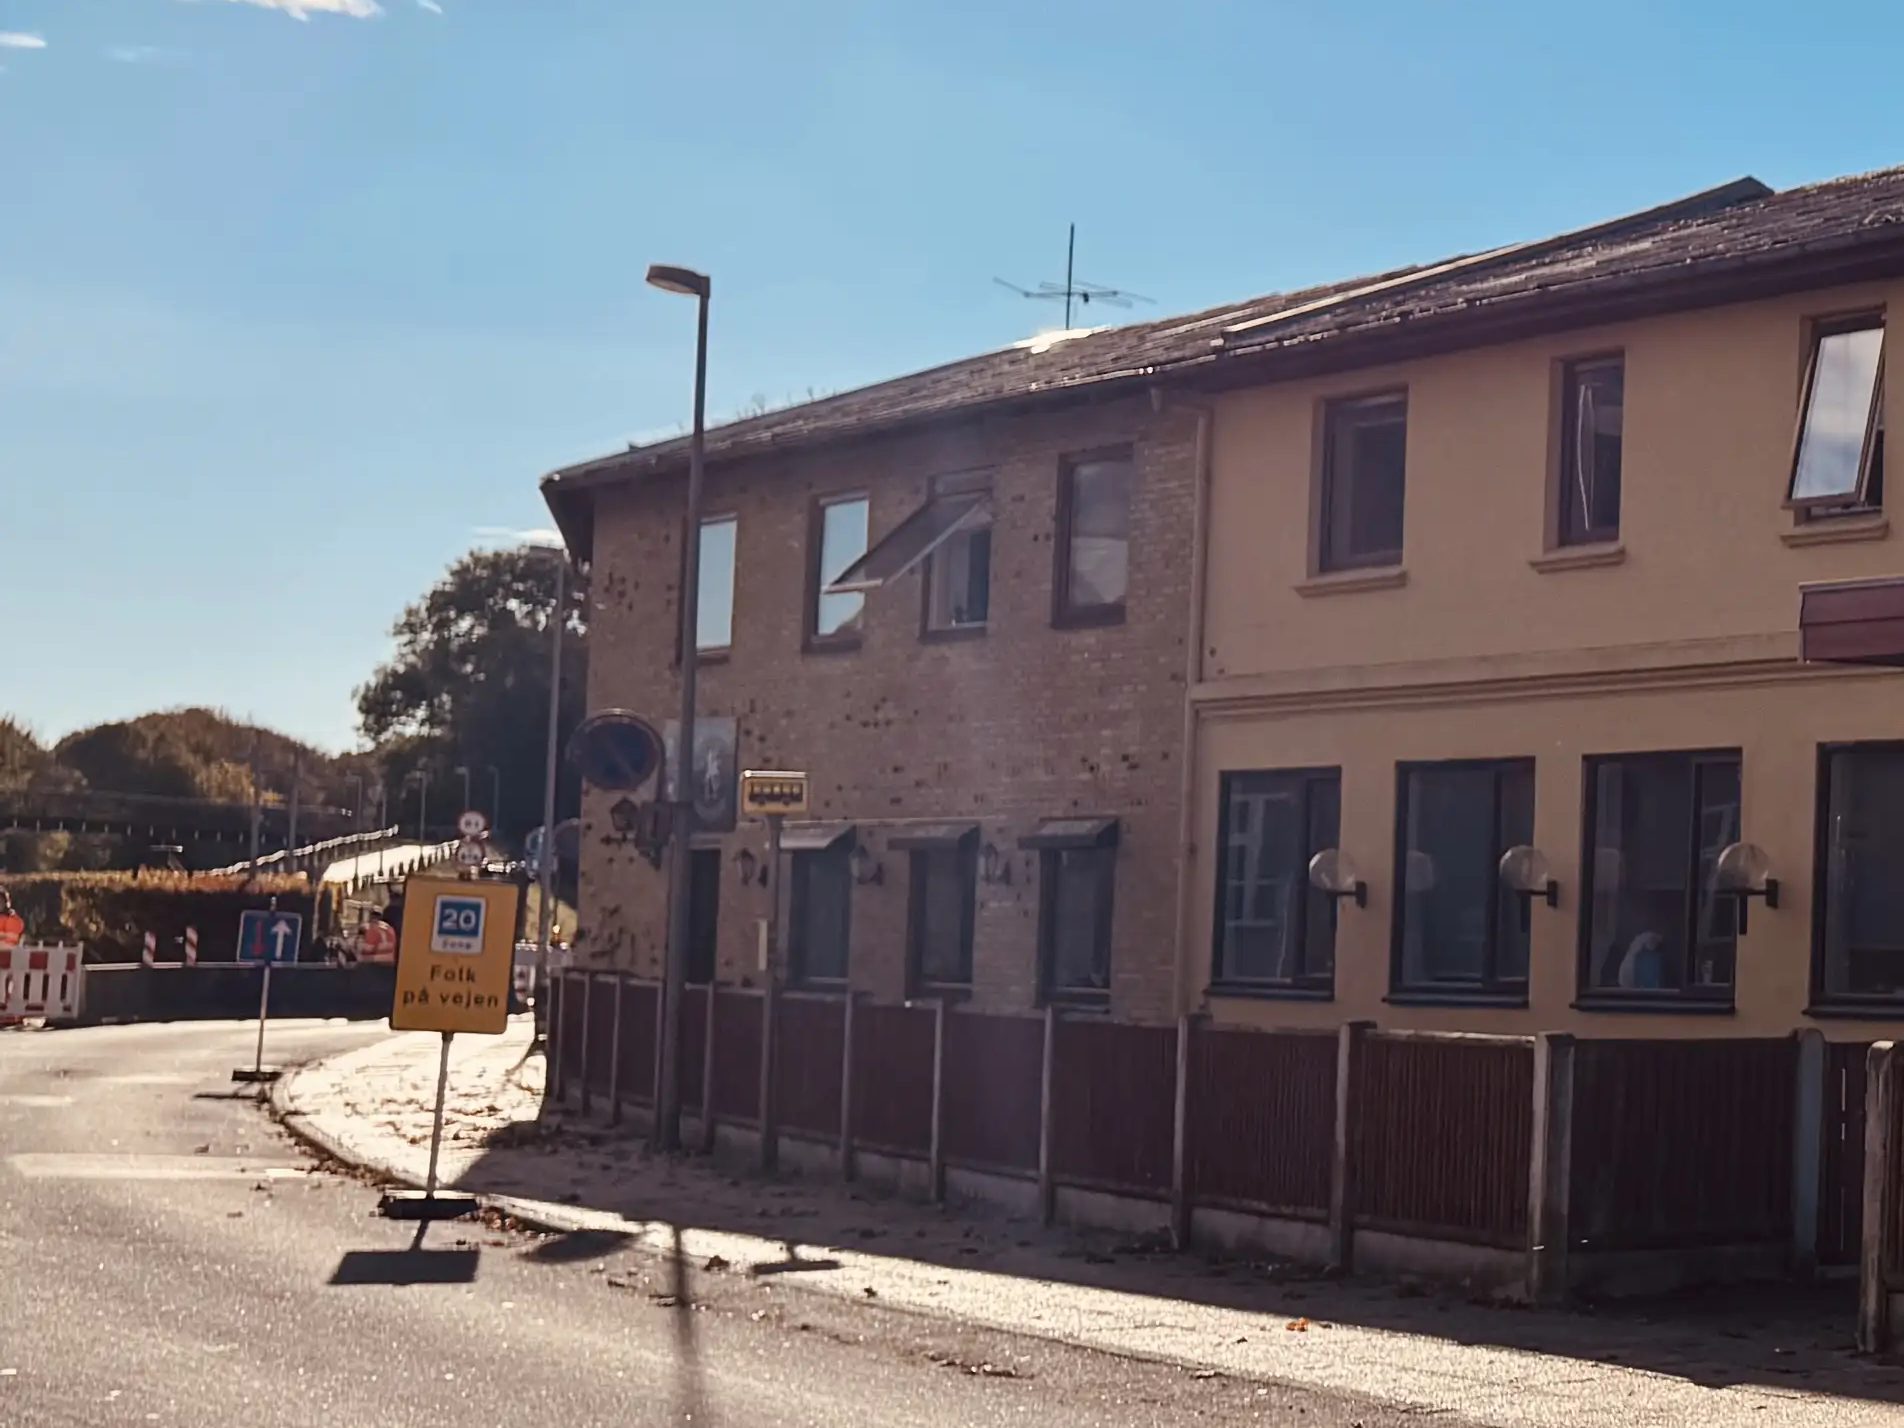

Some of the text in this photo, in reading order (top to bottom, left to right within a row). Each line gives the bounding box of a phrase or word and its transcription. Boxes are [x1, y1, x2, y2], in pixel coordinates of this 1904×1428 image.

[442, 908, 476, 931] 20
[430, 964, 476, 983] Folk
[403, 985, 499, 1011] på vejen
